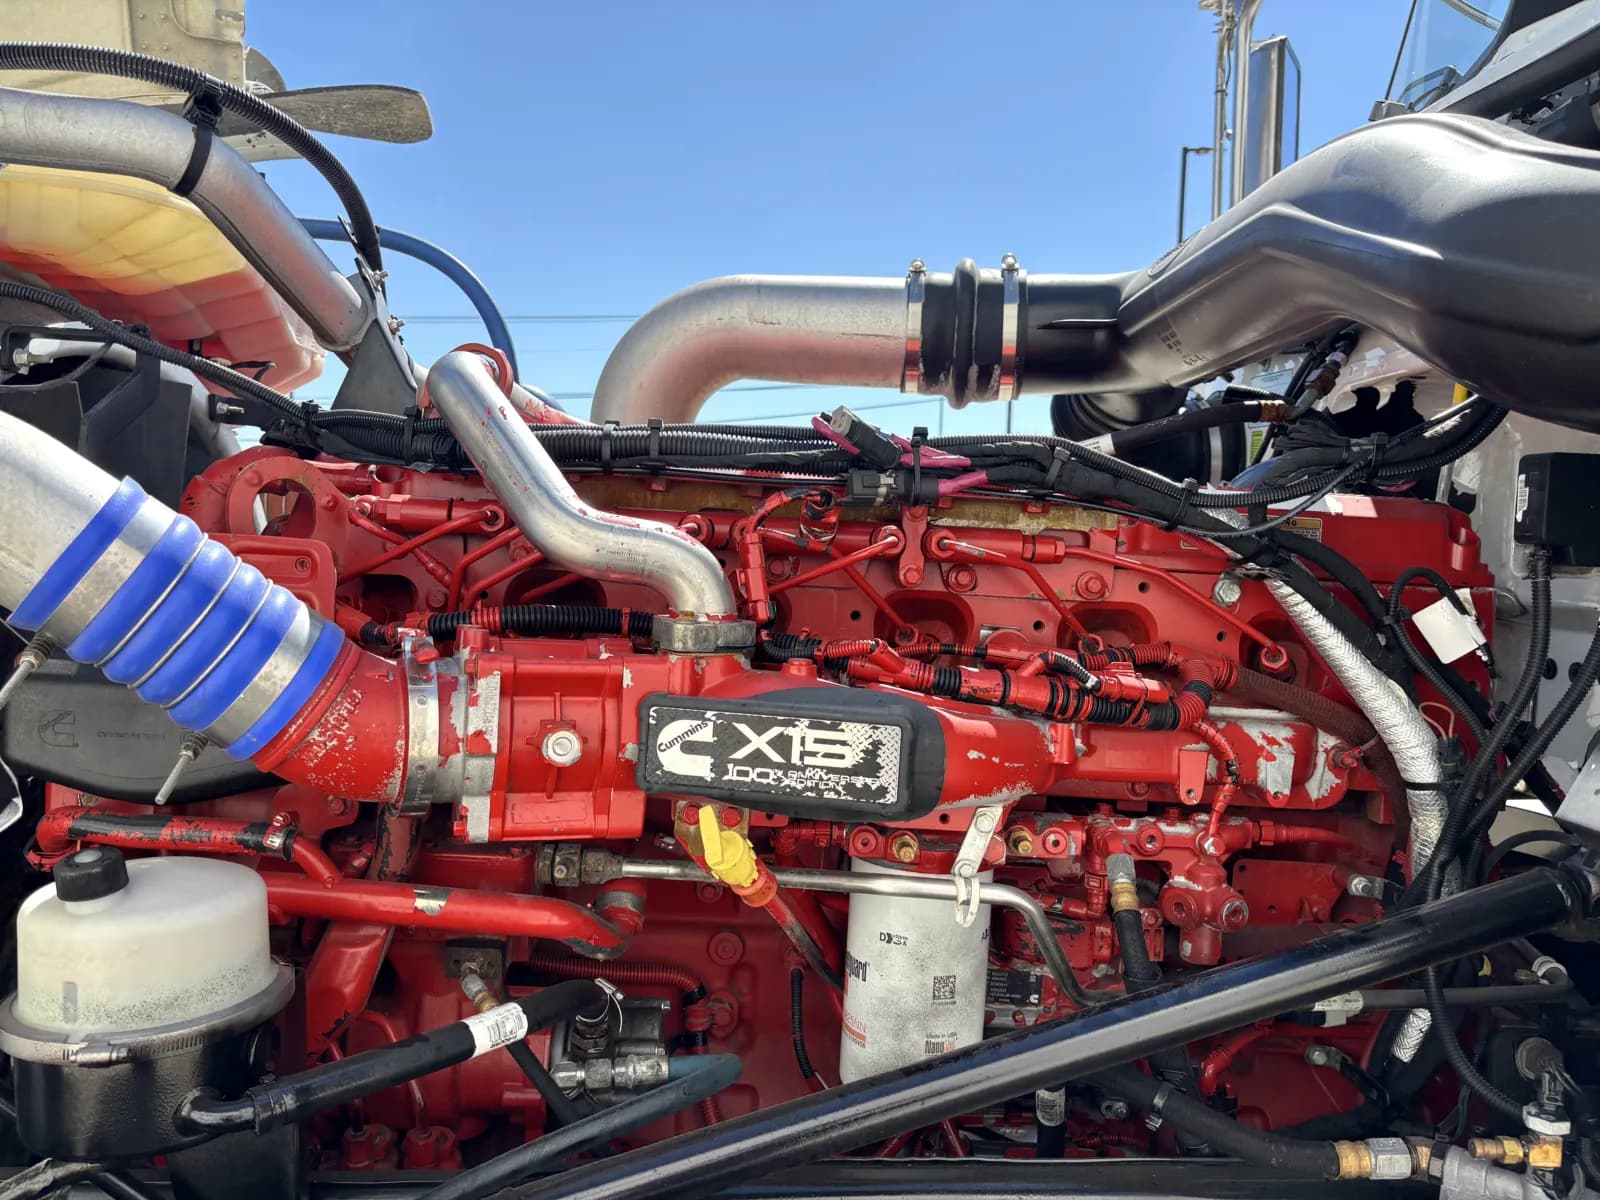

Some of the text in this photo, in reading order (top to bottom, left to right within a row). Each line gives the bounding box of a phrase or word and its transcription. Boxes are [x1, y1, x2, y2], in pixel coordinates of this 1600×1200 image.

[657, 721, 709, 753] Cummins
[728, 722, 859, 768] X15
[787, 770, 882, 787] ANNIVERSAR
